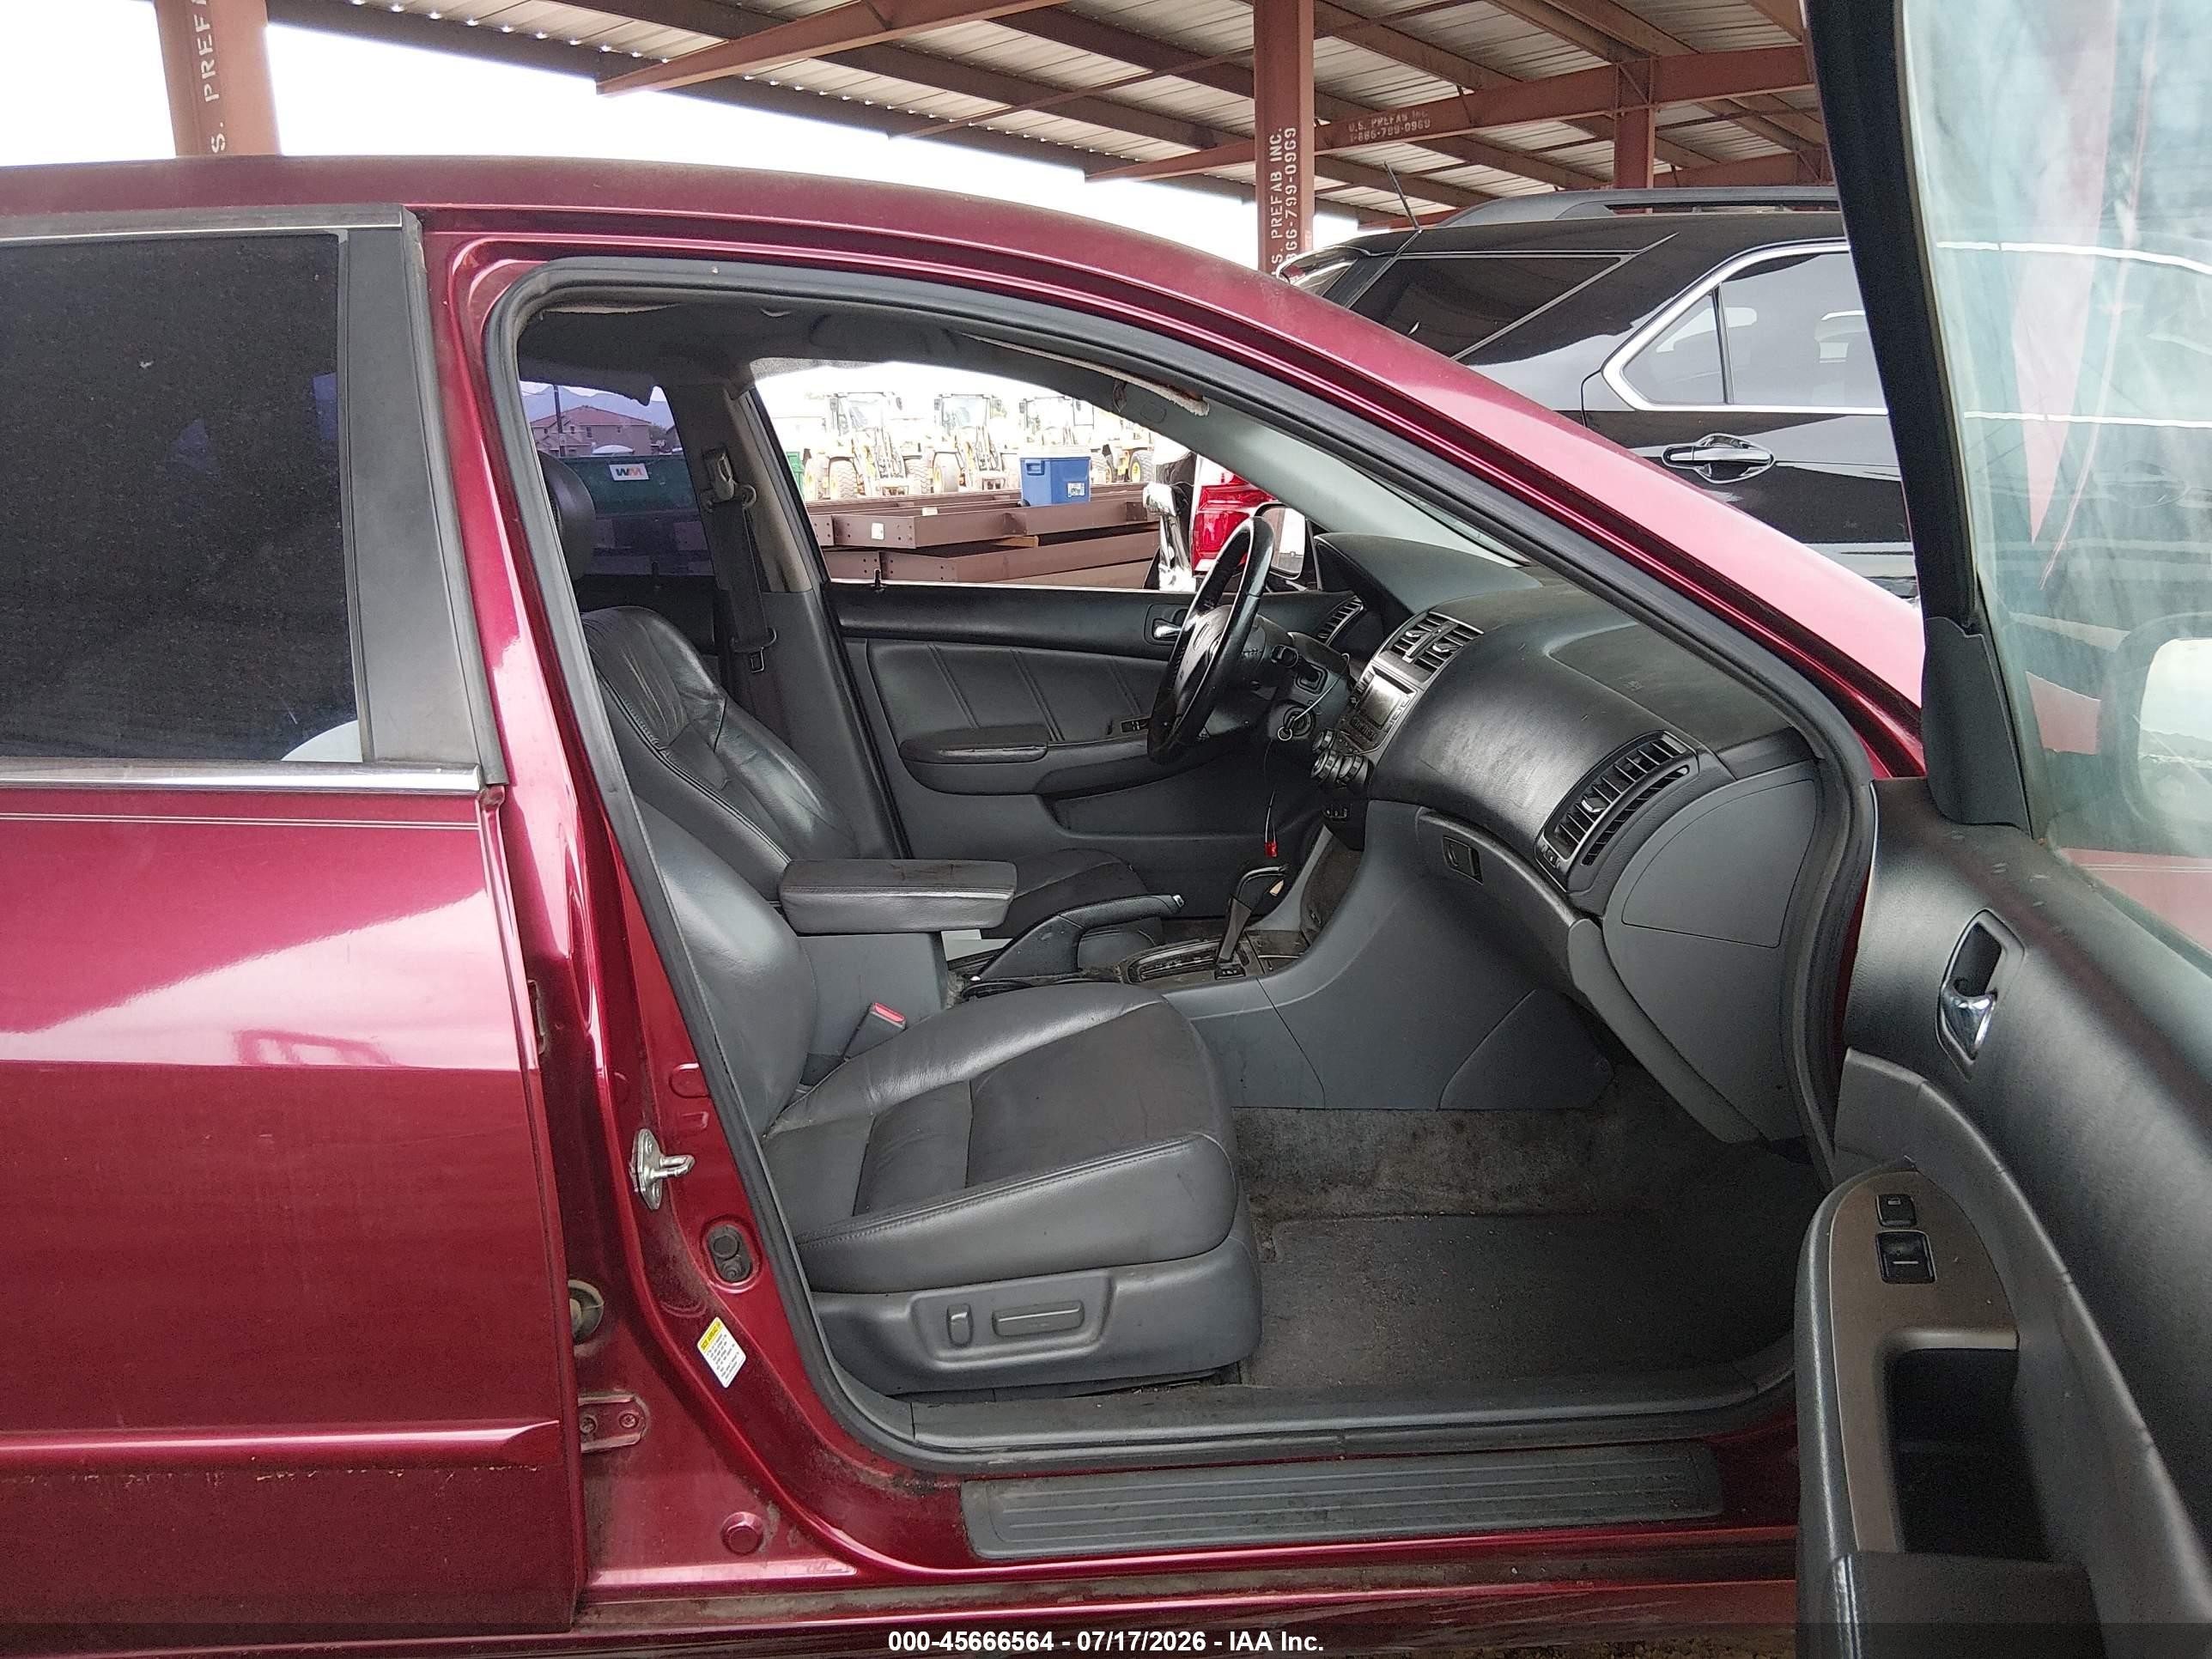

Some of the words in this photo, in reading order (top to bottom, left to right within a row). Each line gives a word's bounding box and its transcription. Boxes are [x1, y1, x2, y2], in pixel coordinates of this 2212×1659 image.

[1348, 121, 1367, 132] U.S.
[1371, 114, 1408, 128] PREFAB
[1269, 127, 1283, 162] INC.
[1270, 171, 1283, 239] PREFAB
[616, 467, 642, 476] WM
